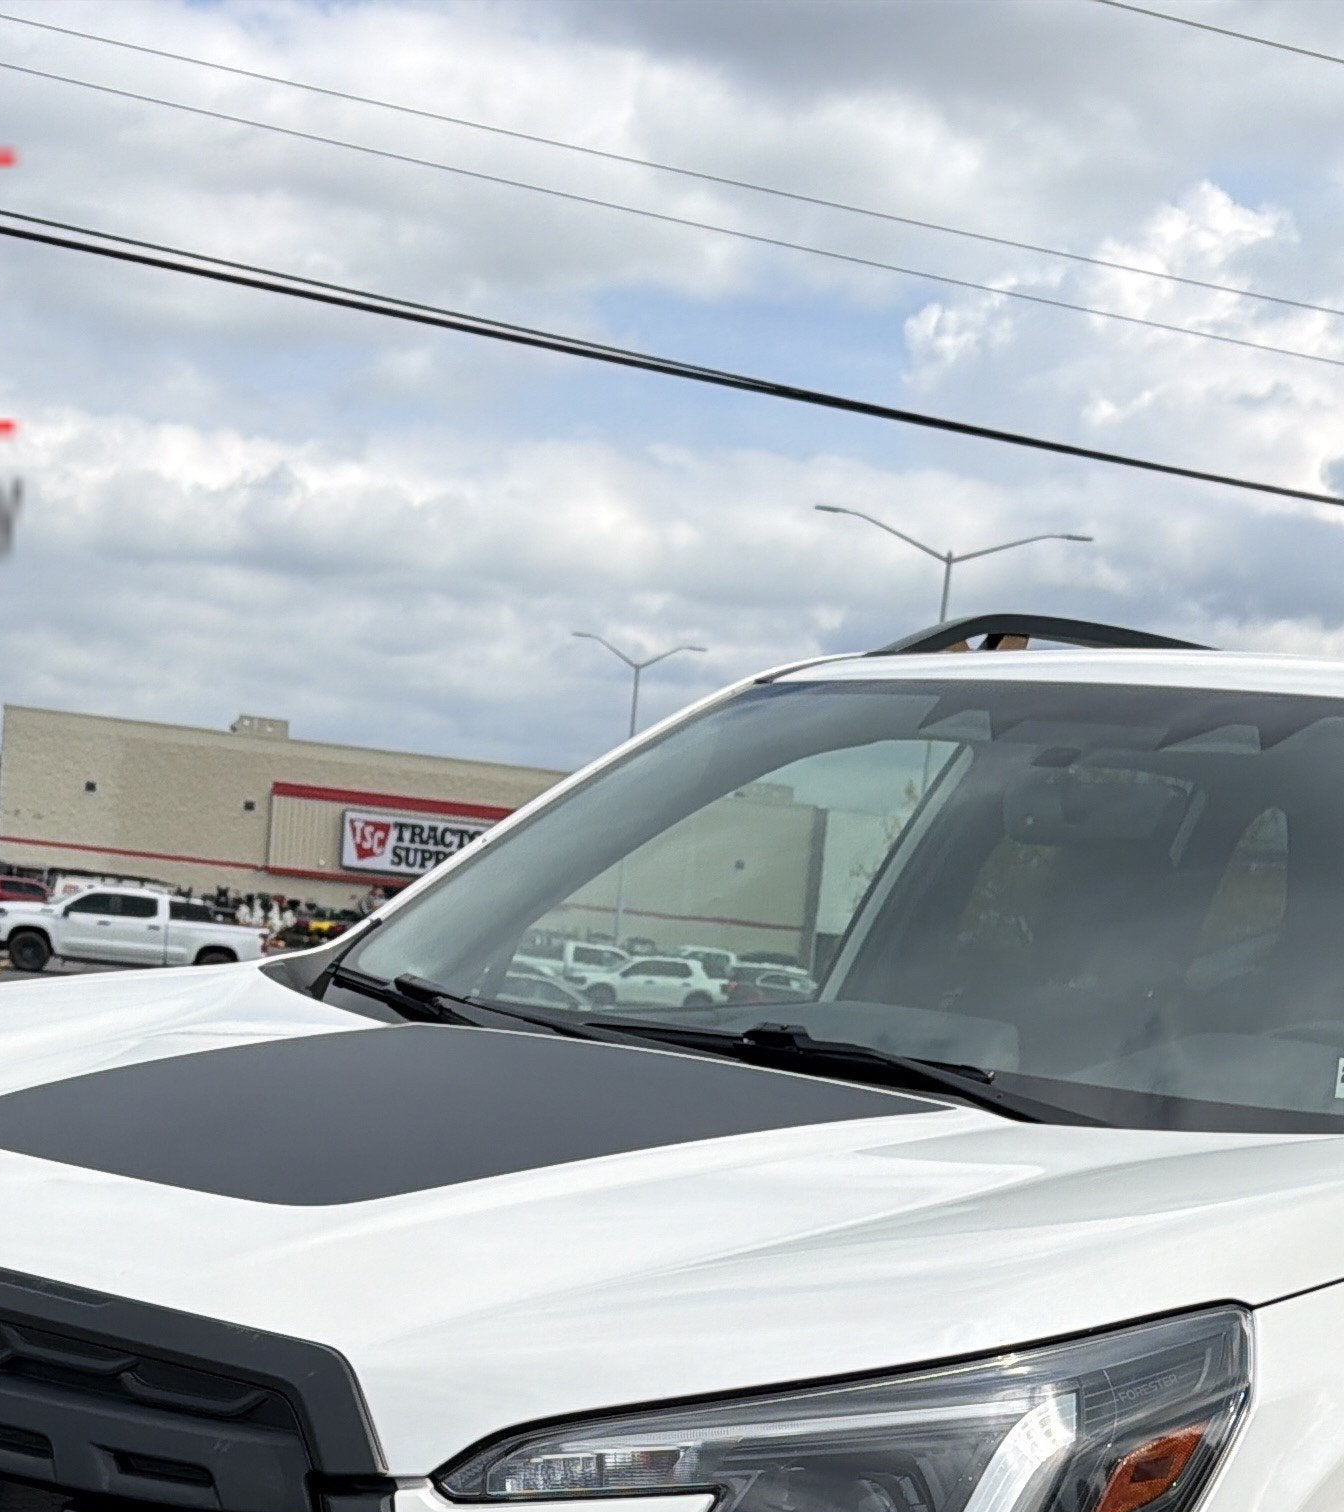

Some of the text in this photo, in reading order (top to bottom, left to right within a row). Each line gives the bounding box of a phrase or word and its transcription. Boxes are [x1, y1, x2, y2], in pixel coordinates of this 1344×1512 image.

[353, 820, 386, 855] TSC
[394, 822, 483, 849] TRACT
[390, 845, 454, 869] SUPP
